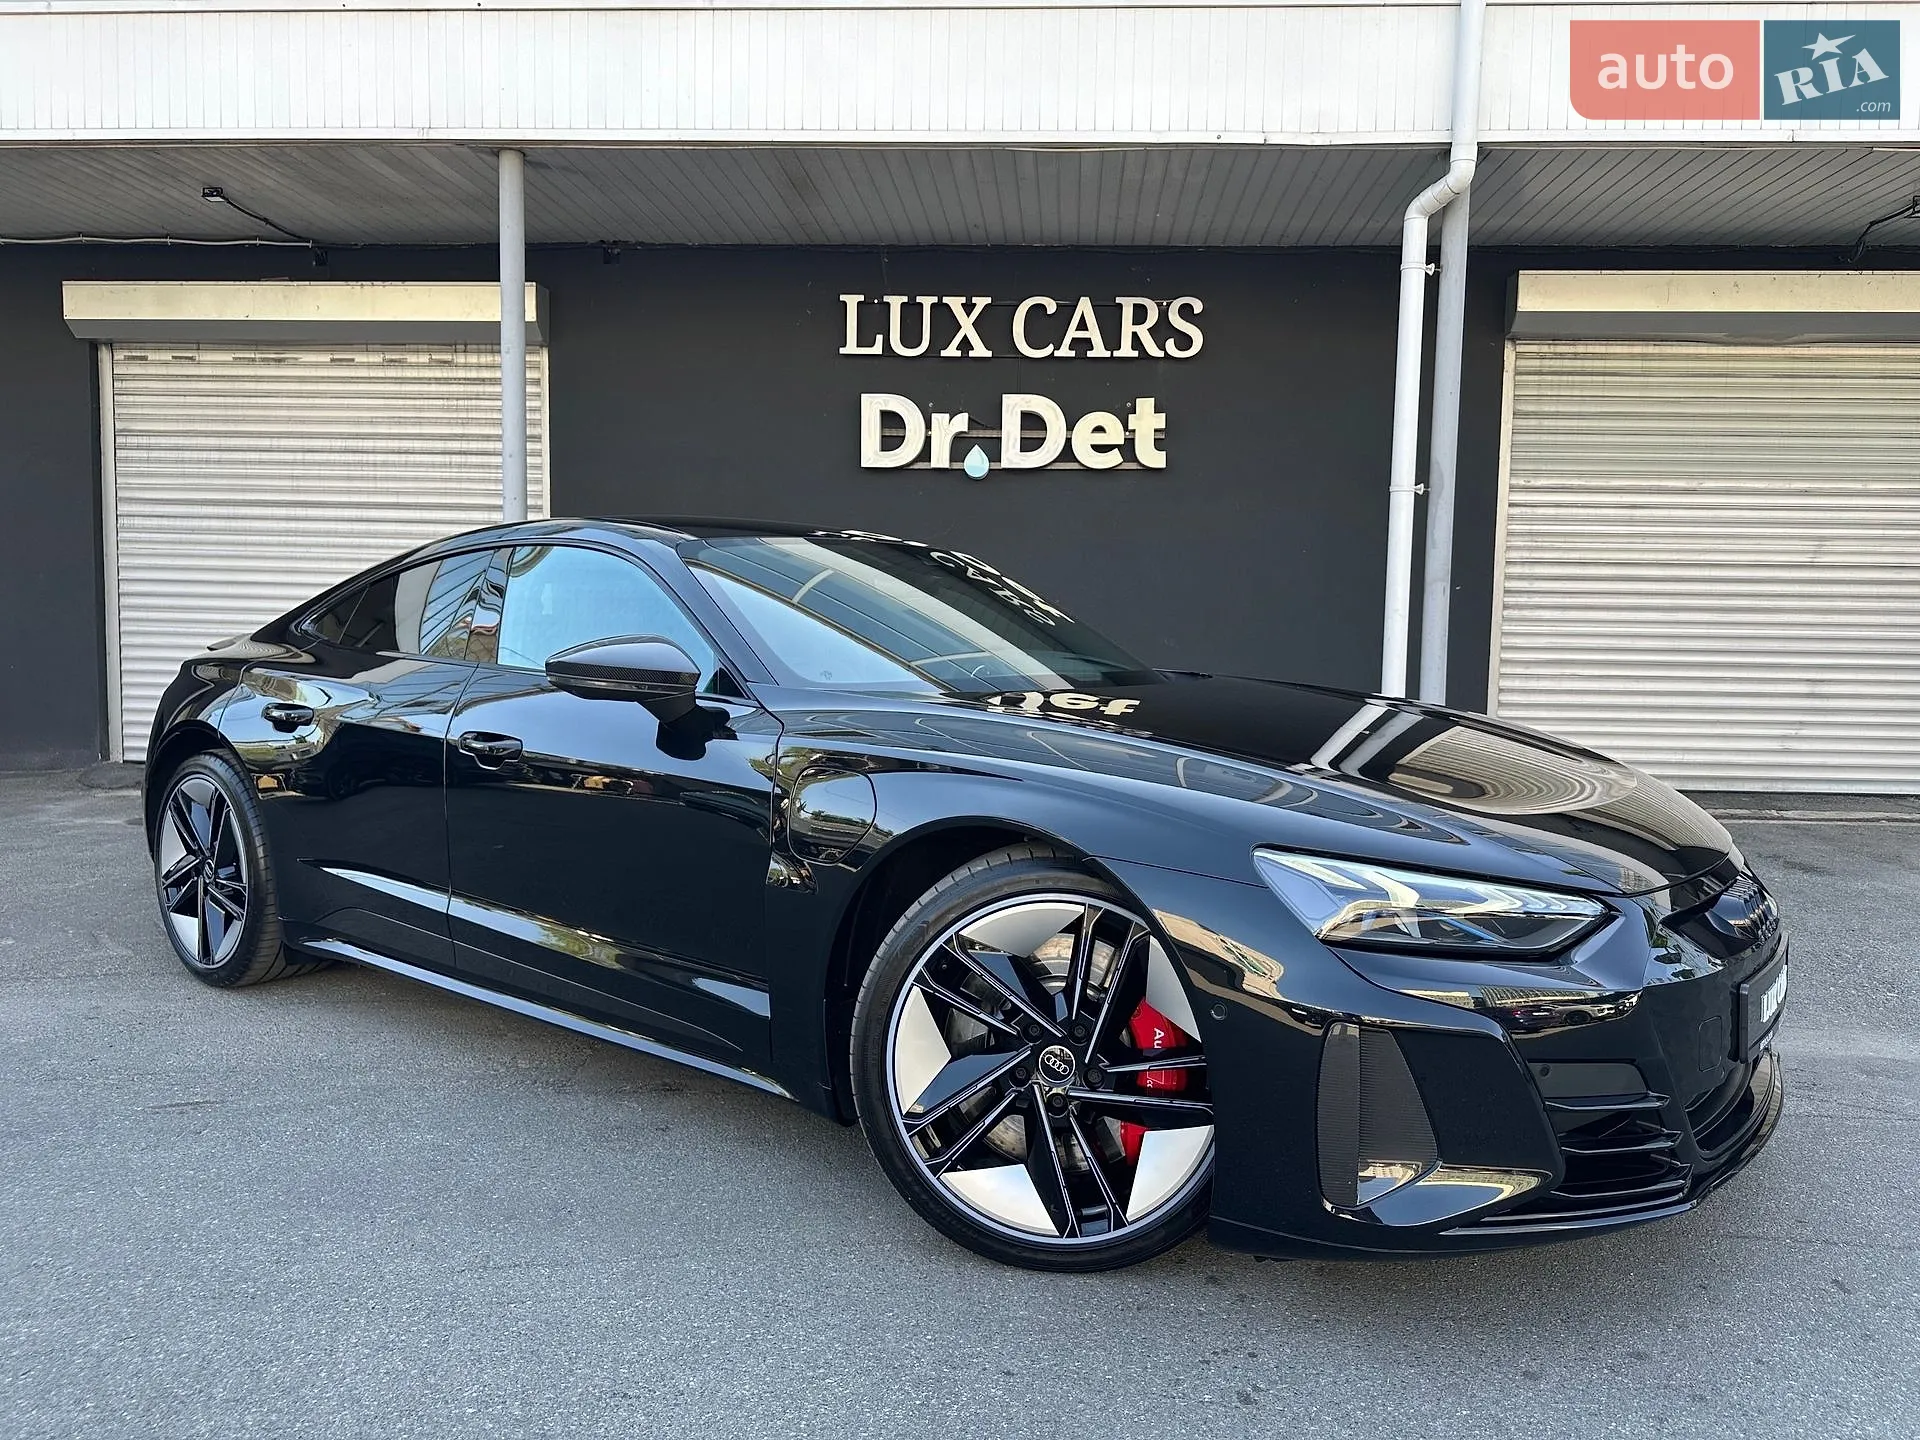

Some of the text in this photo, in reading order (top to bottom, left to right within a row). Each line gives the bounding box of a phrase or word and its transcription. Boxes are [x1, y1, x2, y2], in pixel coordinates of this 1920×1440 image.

[839, 294, 1205, 359] LUX CARS
[1153, 1027, 1165, 1049] Au
